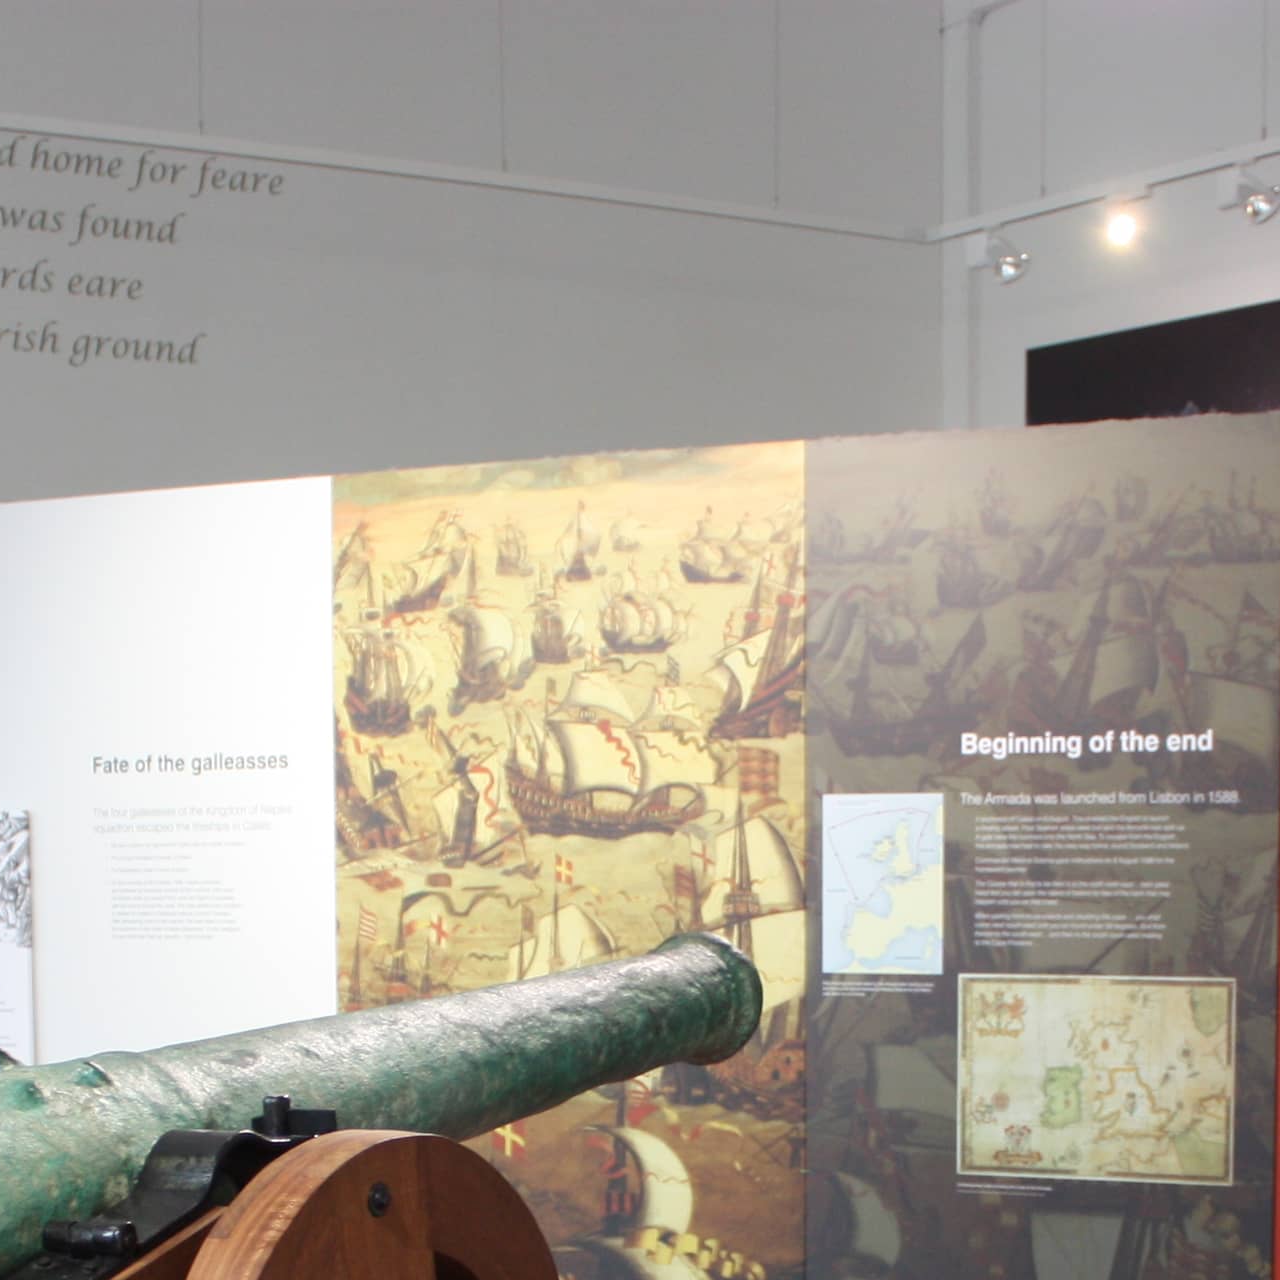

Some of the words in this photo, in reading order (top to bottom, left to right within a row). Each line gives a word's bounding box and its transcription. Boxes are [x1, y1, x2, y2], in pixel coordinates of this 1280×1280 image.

[29, 139, 122, 180] home
[127, 149, 186, 191] for
[192, 155, 286, 199] feare
[68, 203, 185, 246] found
[67, 273, 144, 302] eare
[68, 326, 208, 368] ground
[960, 732, 1082, 760] Beginning
[1089, 730, 1114, 752] of
[1120, 729, 1159, 752] the
[1166, 729, 1214, 751] end
[92, 756, 129, 774] Fate
[135, 755, 152, 773] of
[158, 755, 185, 772] the
[191, 753, 289, 776] galleasses
[960, 792, 983, 805] The
[984, 792, 1031, 805] Armada
[1033, 795, 1058, 805] was
[1060, 791, 1117, 805] launched
[1119, 791, 1147, 804] from
[1149, 791, 1190, 804] Lisbon
[1193, 792, 1205, 803] in
